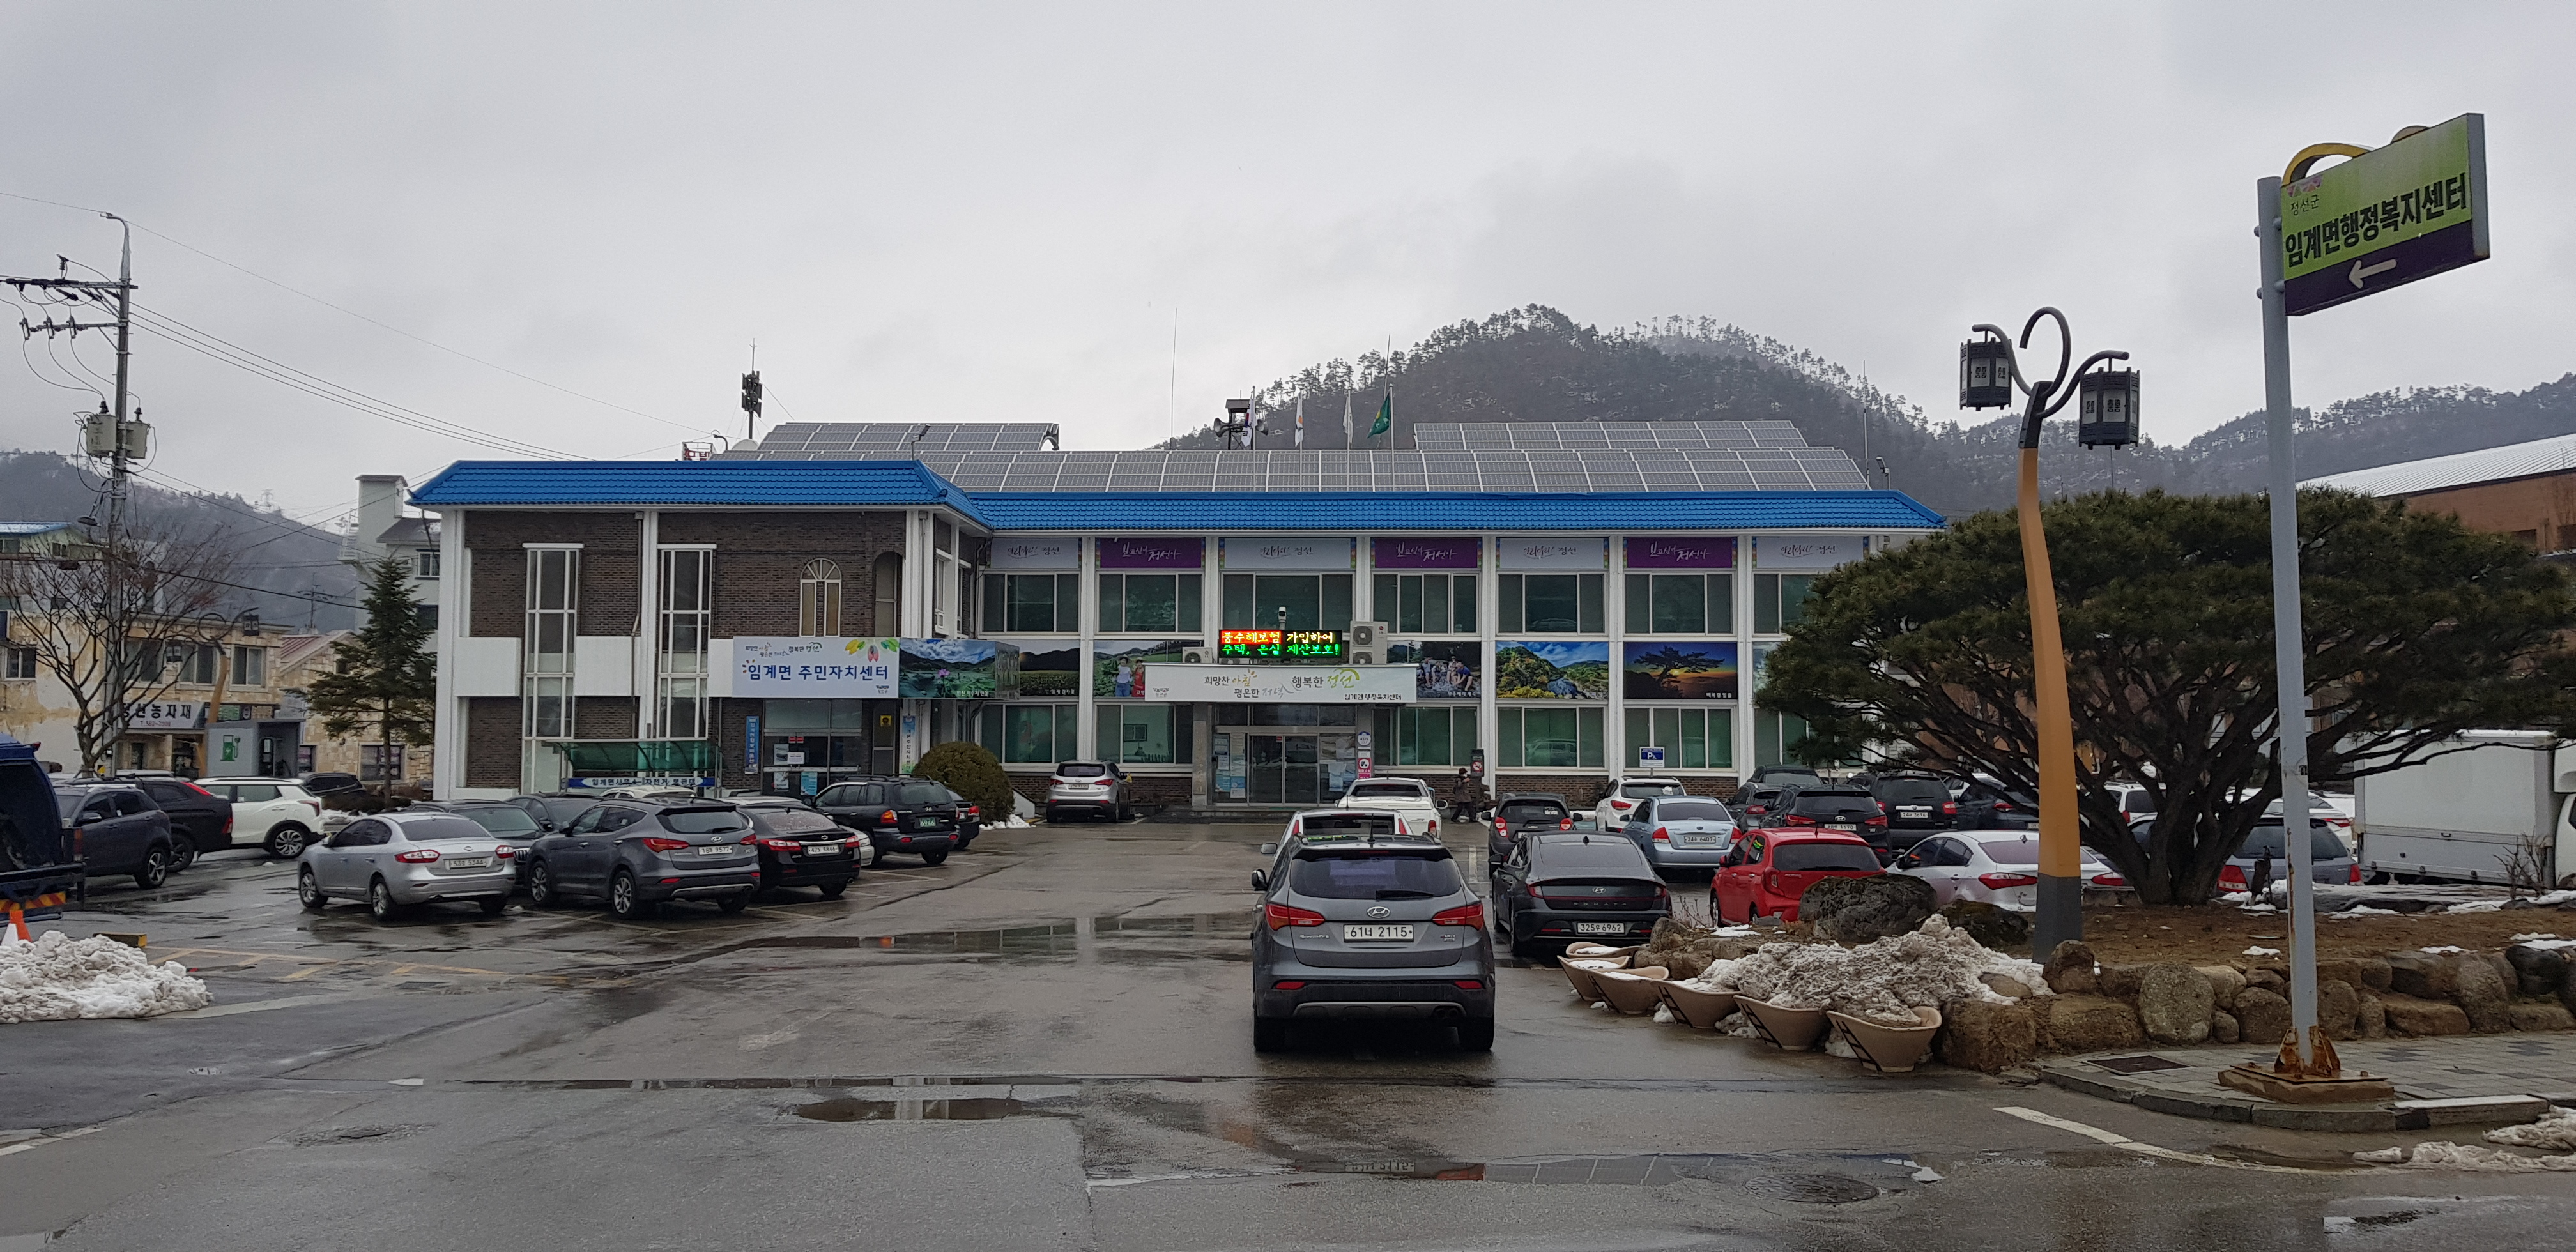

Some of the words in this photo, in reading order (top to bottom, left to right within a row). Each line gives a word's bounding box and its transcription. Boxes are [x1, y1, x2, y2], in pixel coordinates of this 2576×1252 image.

[2290, 194, 2320, 216] 정선군
[2285, 172, 2469, 268] 임계면행정복지센터
[1222, 631, 1280, 643] 풍수해보험
[1286, 631, 1333, 643] 가입하여
[1222, 644, 1250, 655] 주택,
[1257, 644, 1280, 655] 온실
[1286, 643, 1339, 655] 재산보호!
[748, 664, 792, 680] 임계면
[798, 665, 888, 681] 주민자치센터
[1204, 676, 1230, 687] 희망찬
[1231, 673, 1254, 687] 아침
[1291, 676, 1324, 689] 행복한
[1326, 670, 1358, 689] 정선
[1234, 688, 1260, 698] 평온한
[1350, 926, 1372, 938] 61너
[1378, 926, 1407, 938] 2115
[1602, 924, 1621, 932] 6962
